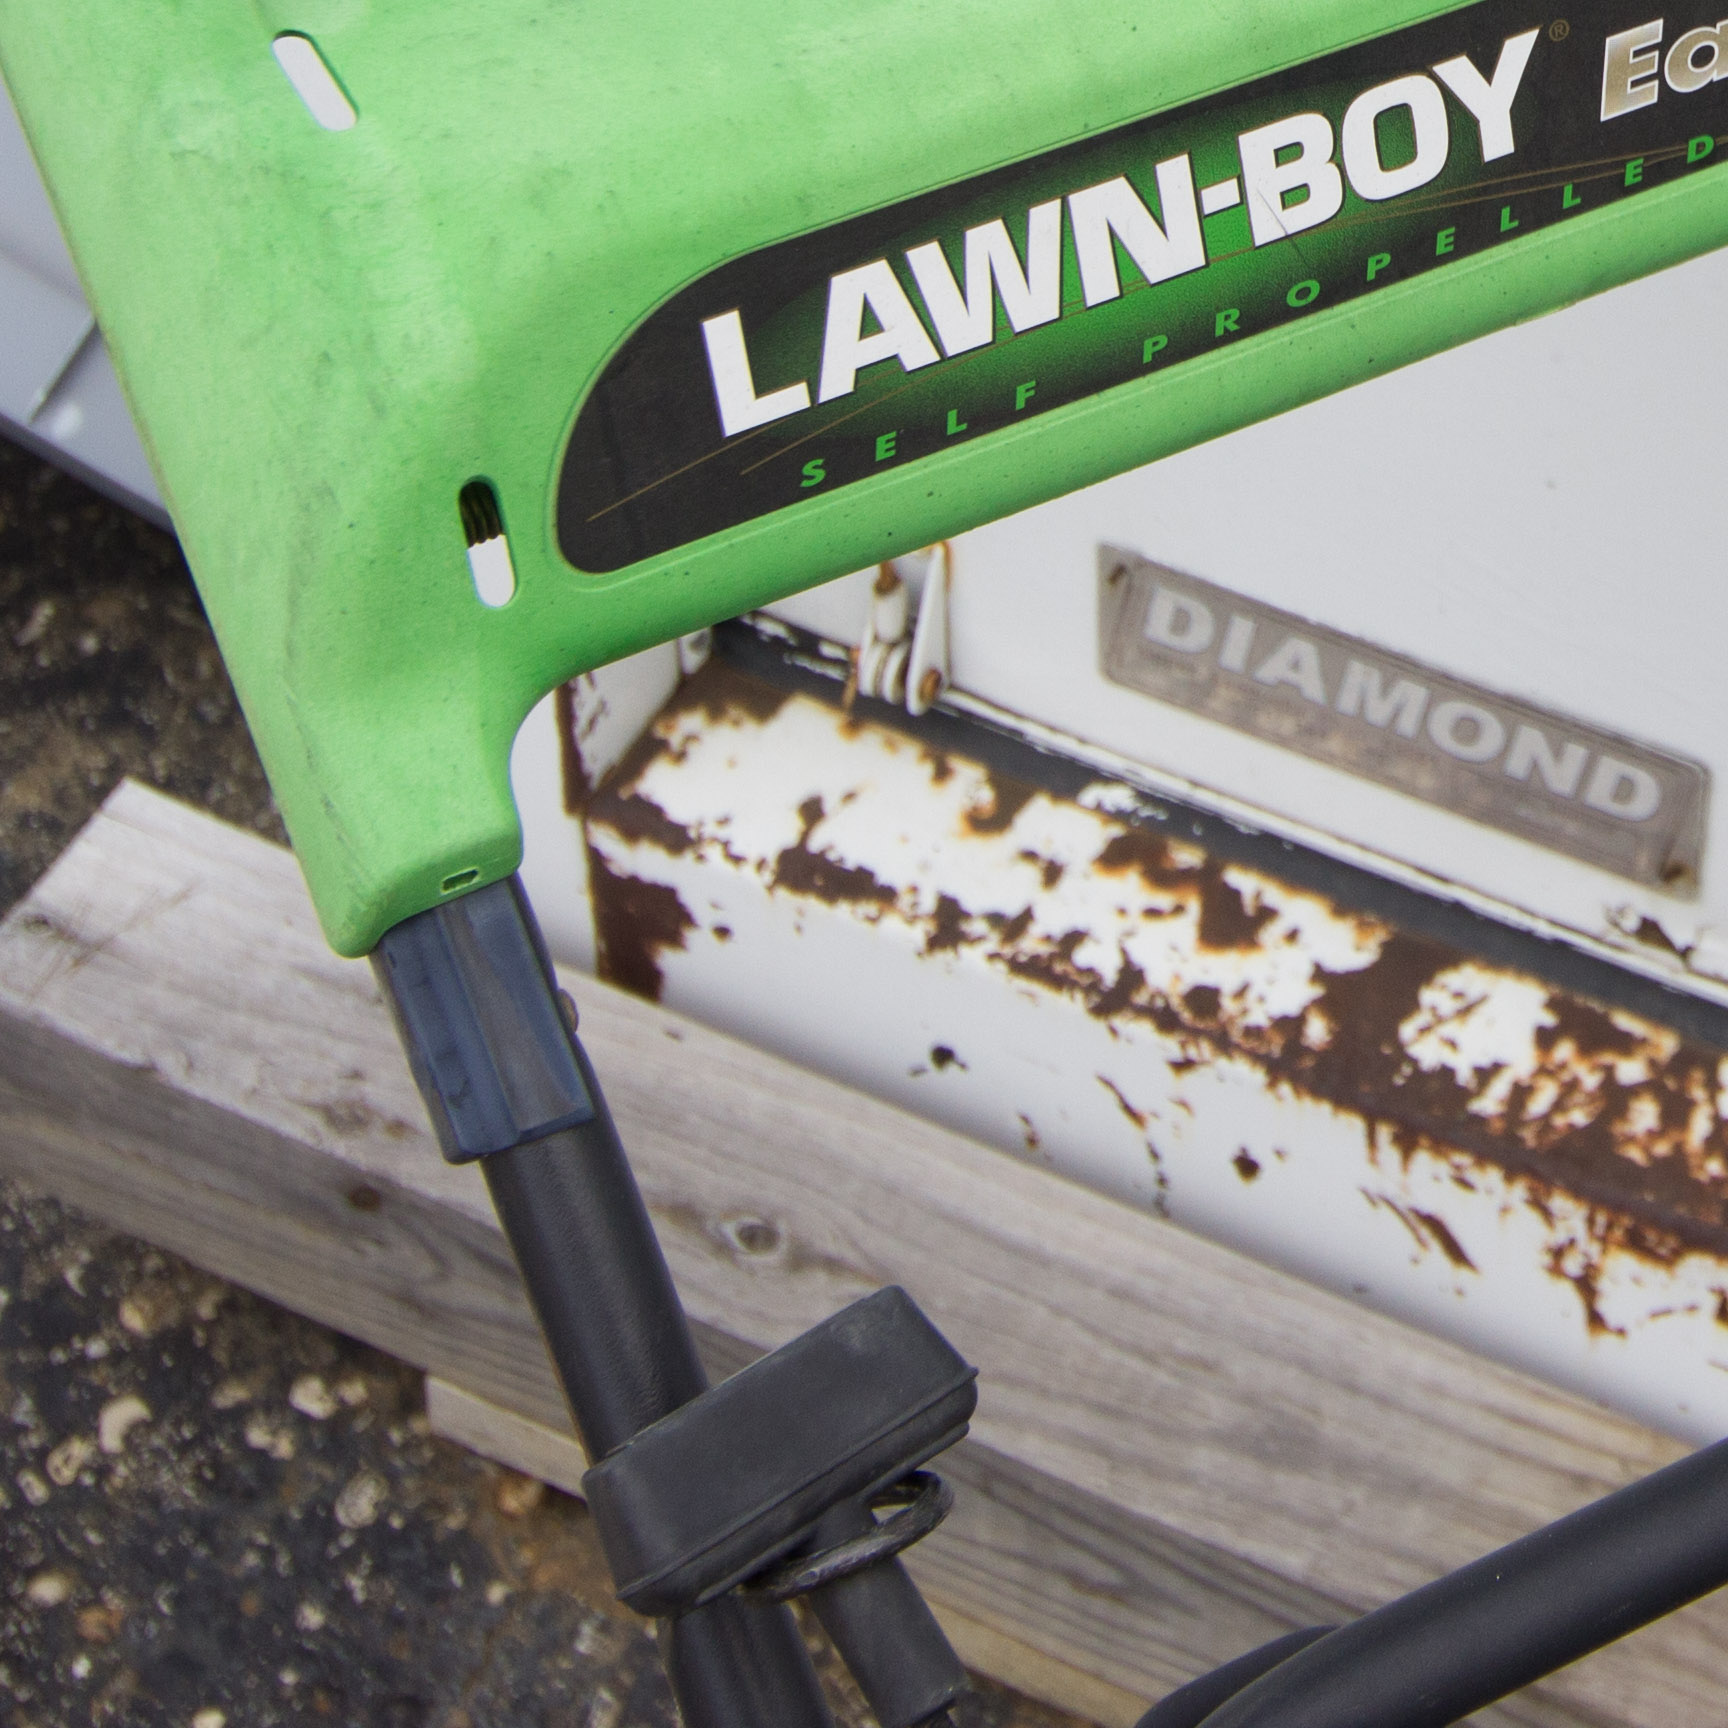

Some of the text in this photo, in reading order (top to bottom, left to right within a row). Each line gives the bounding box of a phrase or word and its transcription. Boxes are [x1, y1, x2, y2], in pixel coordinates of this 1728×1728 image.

[701, 27, 1540, 438] LAWN-BOY
[800, 380, 1037, 489] SELF
[1141, 135, 1715, 365] PROPELLED
[1143, 586, 1661, 823] DIAMOND
